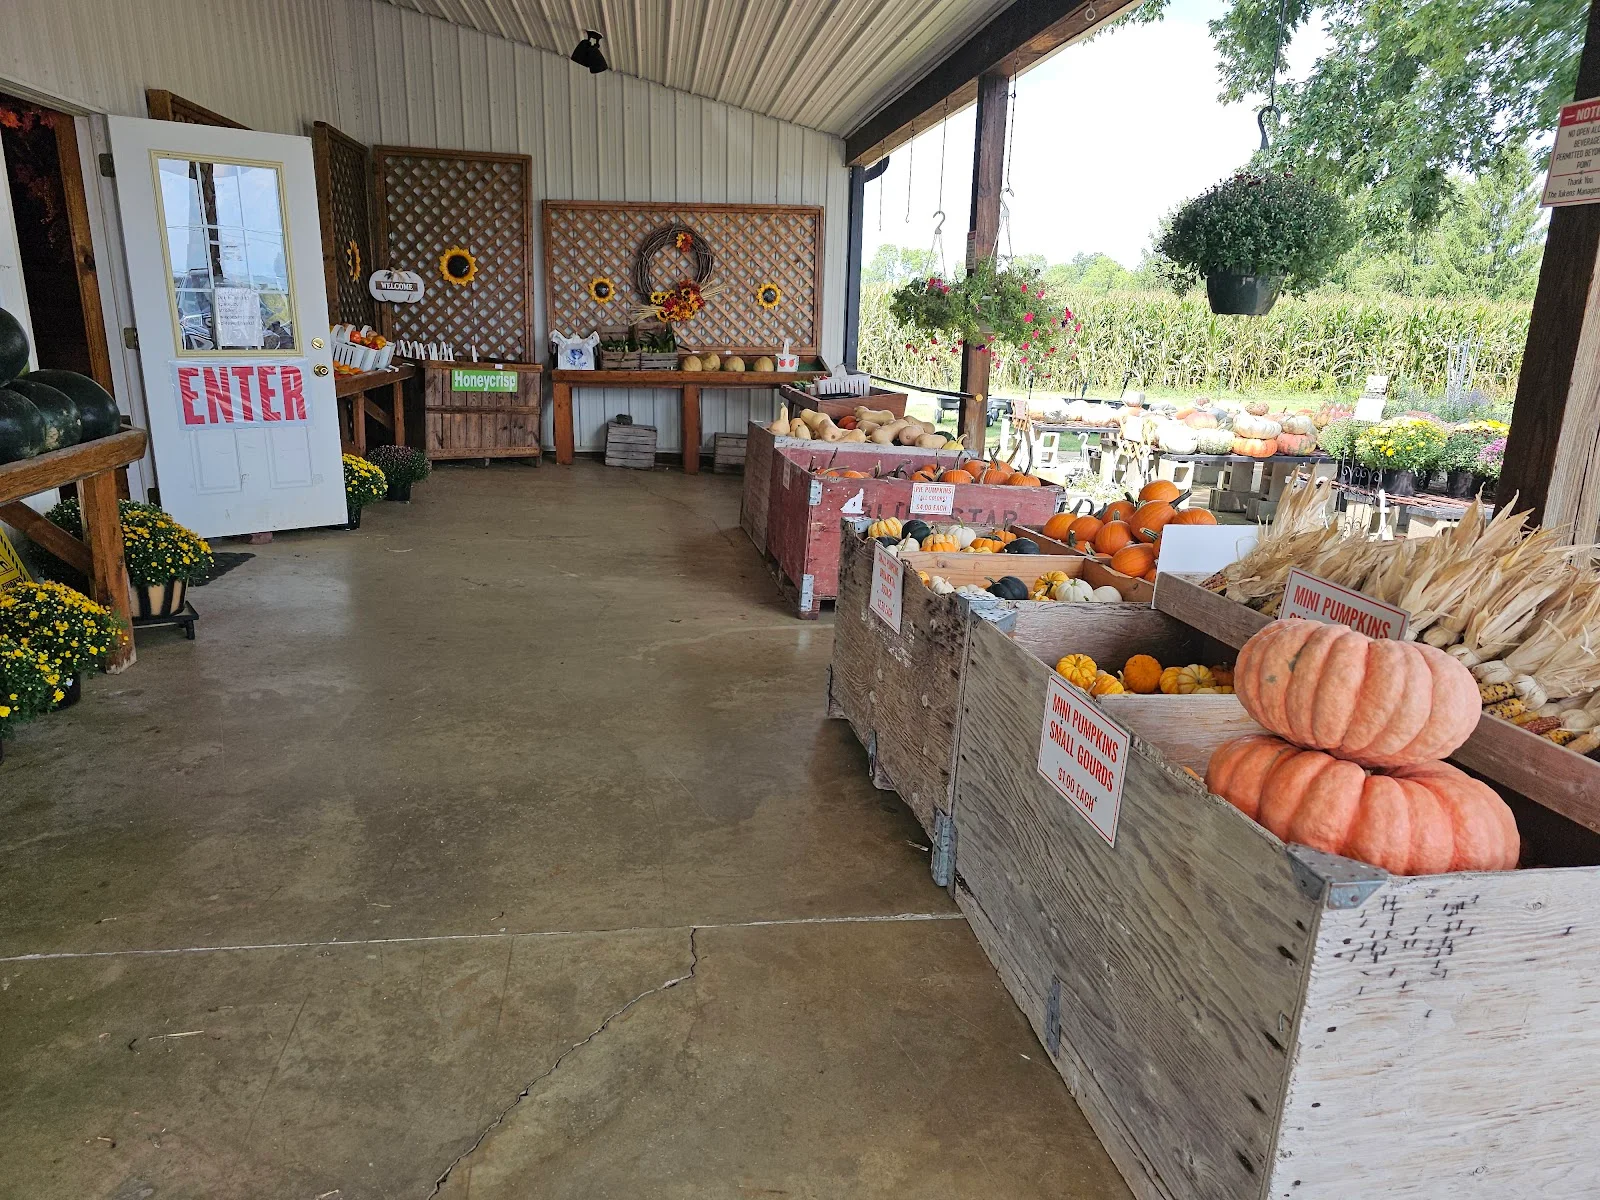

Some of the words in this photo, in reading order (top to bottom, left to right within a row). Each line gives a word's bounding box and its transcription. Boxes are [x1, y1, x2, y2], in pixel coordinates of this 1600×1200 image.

[1568, 130, 1576, 138] NO
[1576, 128, 1590, 137] OPEN
[1556, 150, 1584, 161] PERMITTED
[1577, 160, 1592, 169] POINT
[1568, 177, 1583, 186] Thank
[1585, 176, 1593, 184] You
[381, 282, 414, 291] WELCOME
[454, 371, 516, 391] Honeycrisp
[178, 366, 307, 424] ENTER
[925, 486, 952, 494] PUMPKINS
[1294, 585, 1320, 612] MINI
[1322, 596, 1391, 639] PUMPKINS
[1052, 693, 1071, 723] MINI
[1072, 709, 1119, 764] PUMPKINS
[1050, 720, 1074, 758] SMALL
[1077, 744, 1115, 793] GOURDS
[1058, 767, 1075, 794] $1.00
[1076, 783, 1095, 813] EACH
